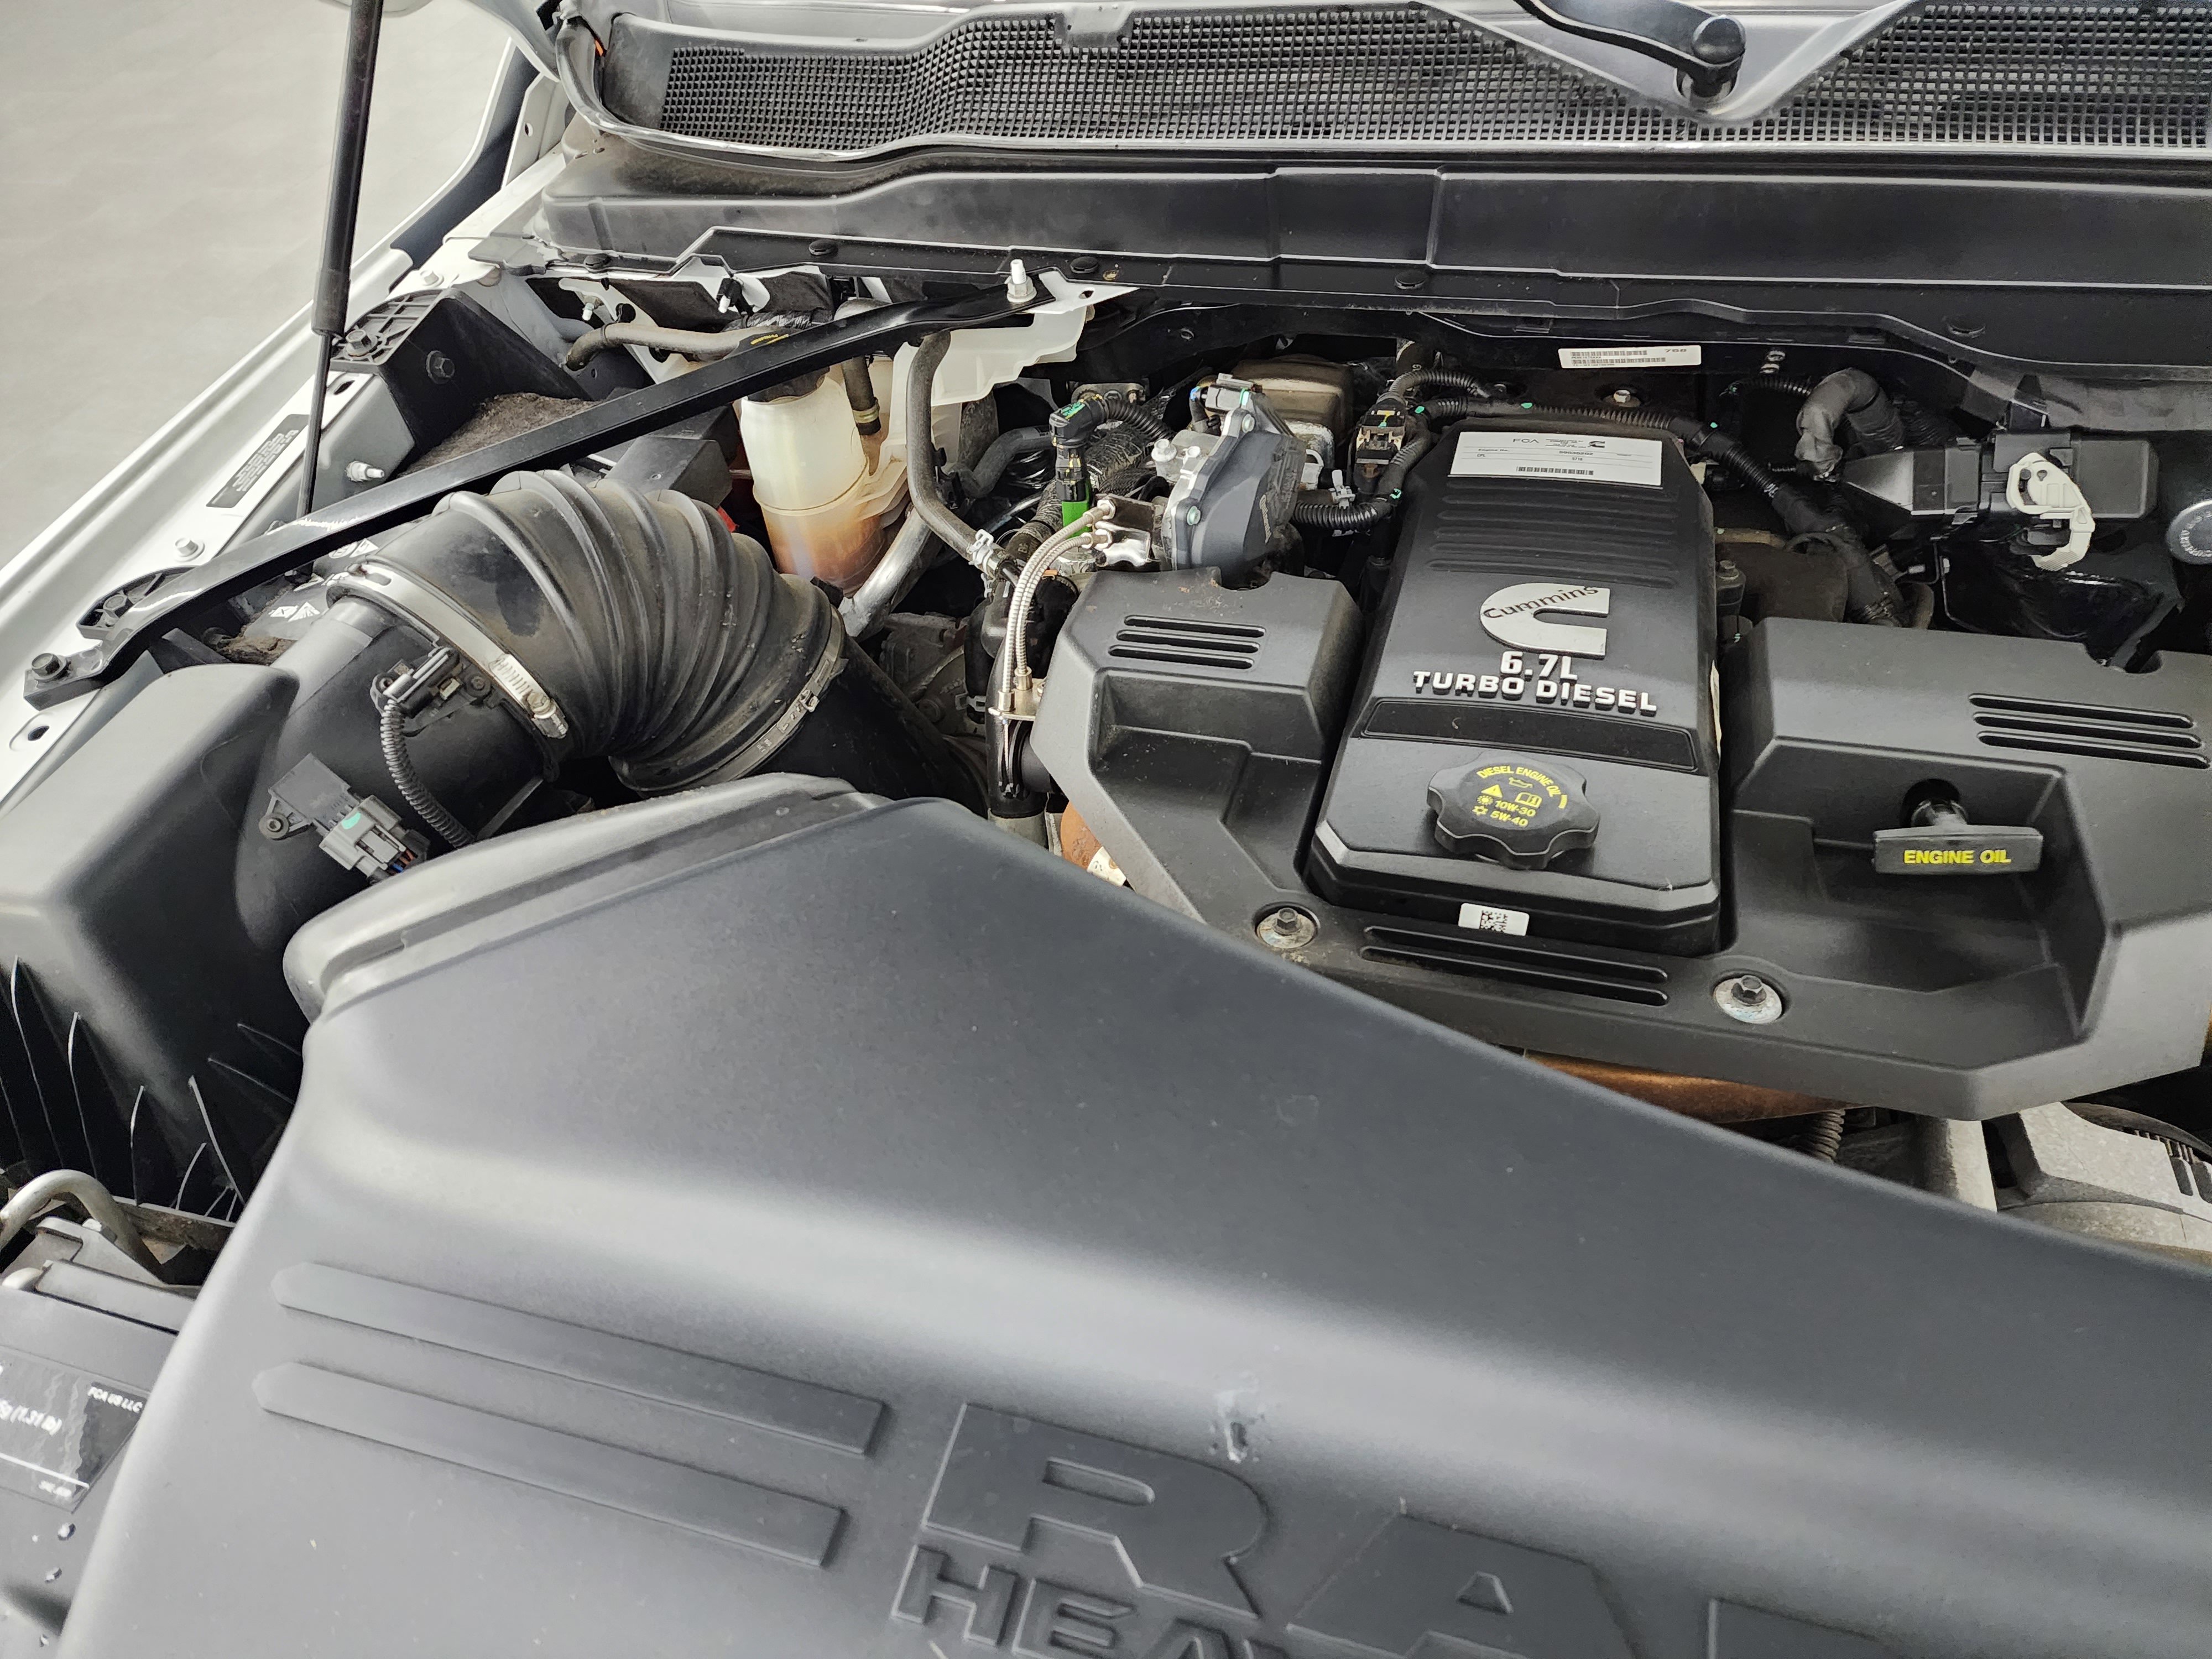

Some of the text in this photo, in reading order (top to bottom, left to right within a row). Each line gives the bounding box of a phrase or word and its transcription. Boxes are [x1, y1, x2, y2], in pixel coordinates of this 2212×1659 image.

[1483, 586, 1599, 619] Cummins
[1500, 650, 1578, 683] 6.7L
[1413, 671, 1657, 717] TURBO DIESEL
[1477, 766, 1562, 797] DIESEL ENGINE OIL
[1490, 810, 1528, 827] 5W-40
[1495, 800, 1536, 817] 10W-30
[1904, 849, 2012, 864] ENGINE OIL
[122, 1397, 143, 1413] LLC
